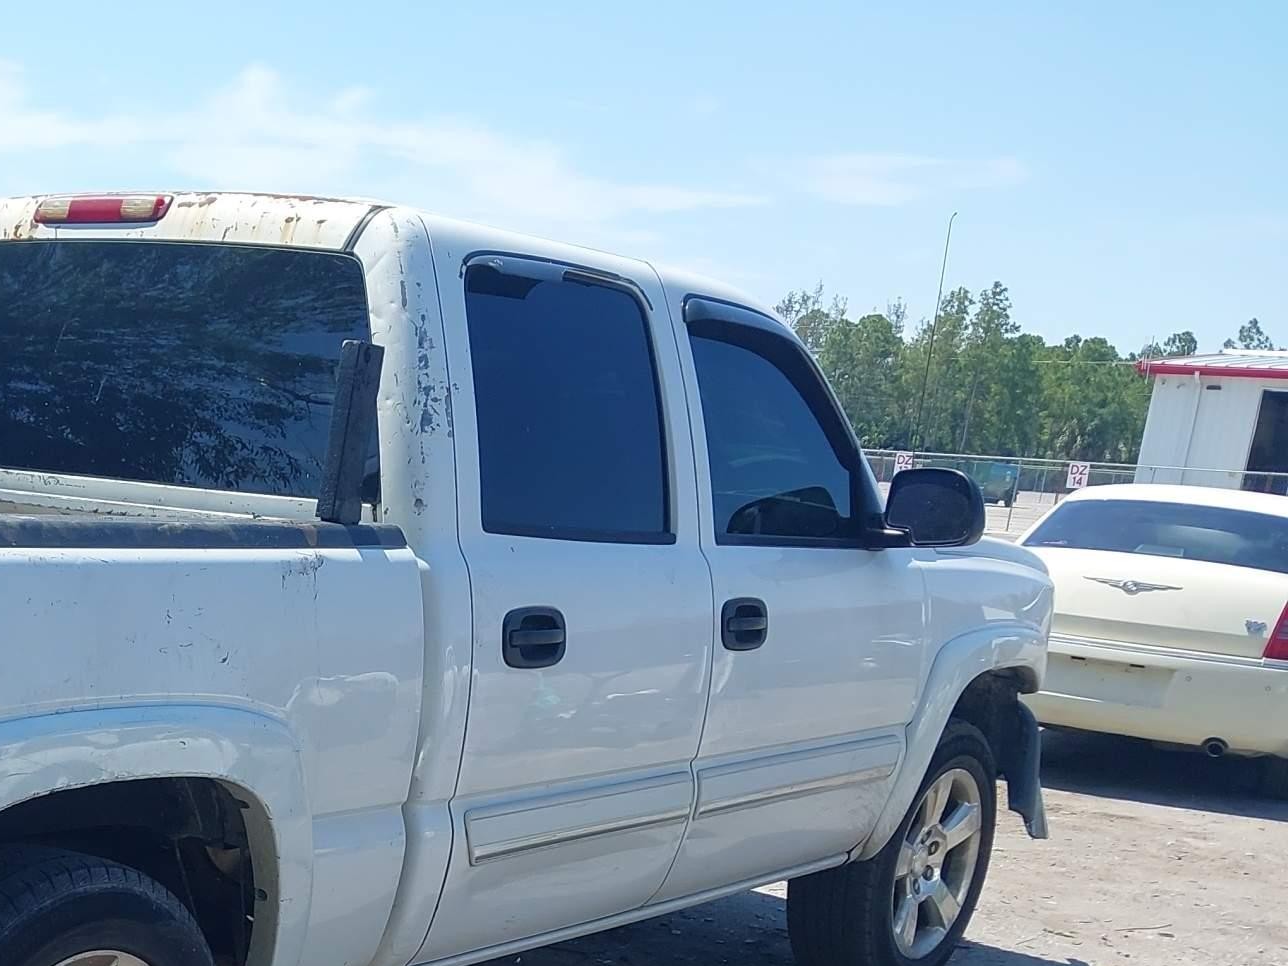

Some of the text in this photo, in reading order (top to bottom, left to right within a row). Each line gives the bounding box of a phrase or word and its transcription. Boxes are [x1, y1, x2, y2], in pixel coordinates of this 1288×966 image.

[897, 454, 913, 465] DZ
[1070, 464, 1088, 475] DZ
[1072, 476, 1083, 486] 14
